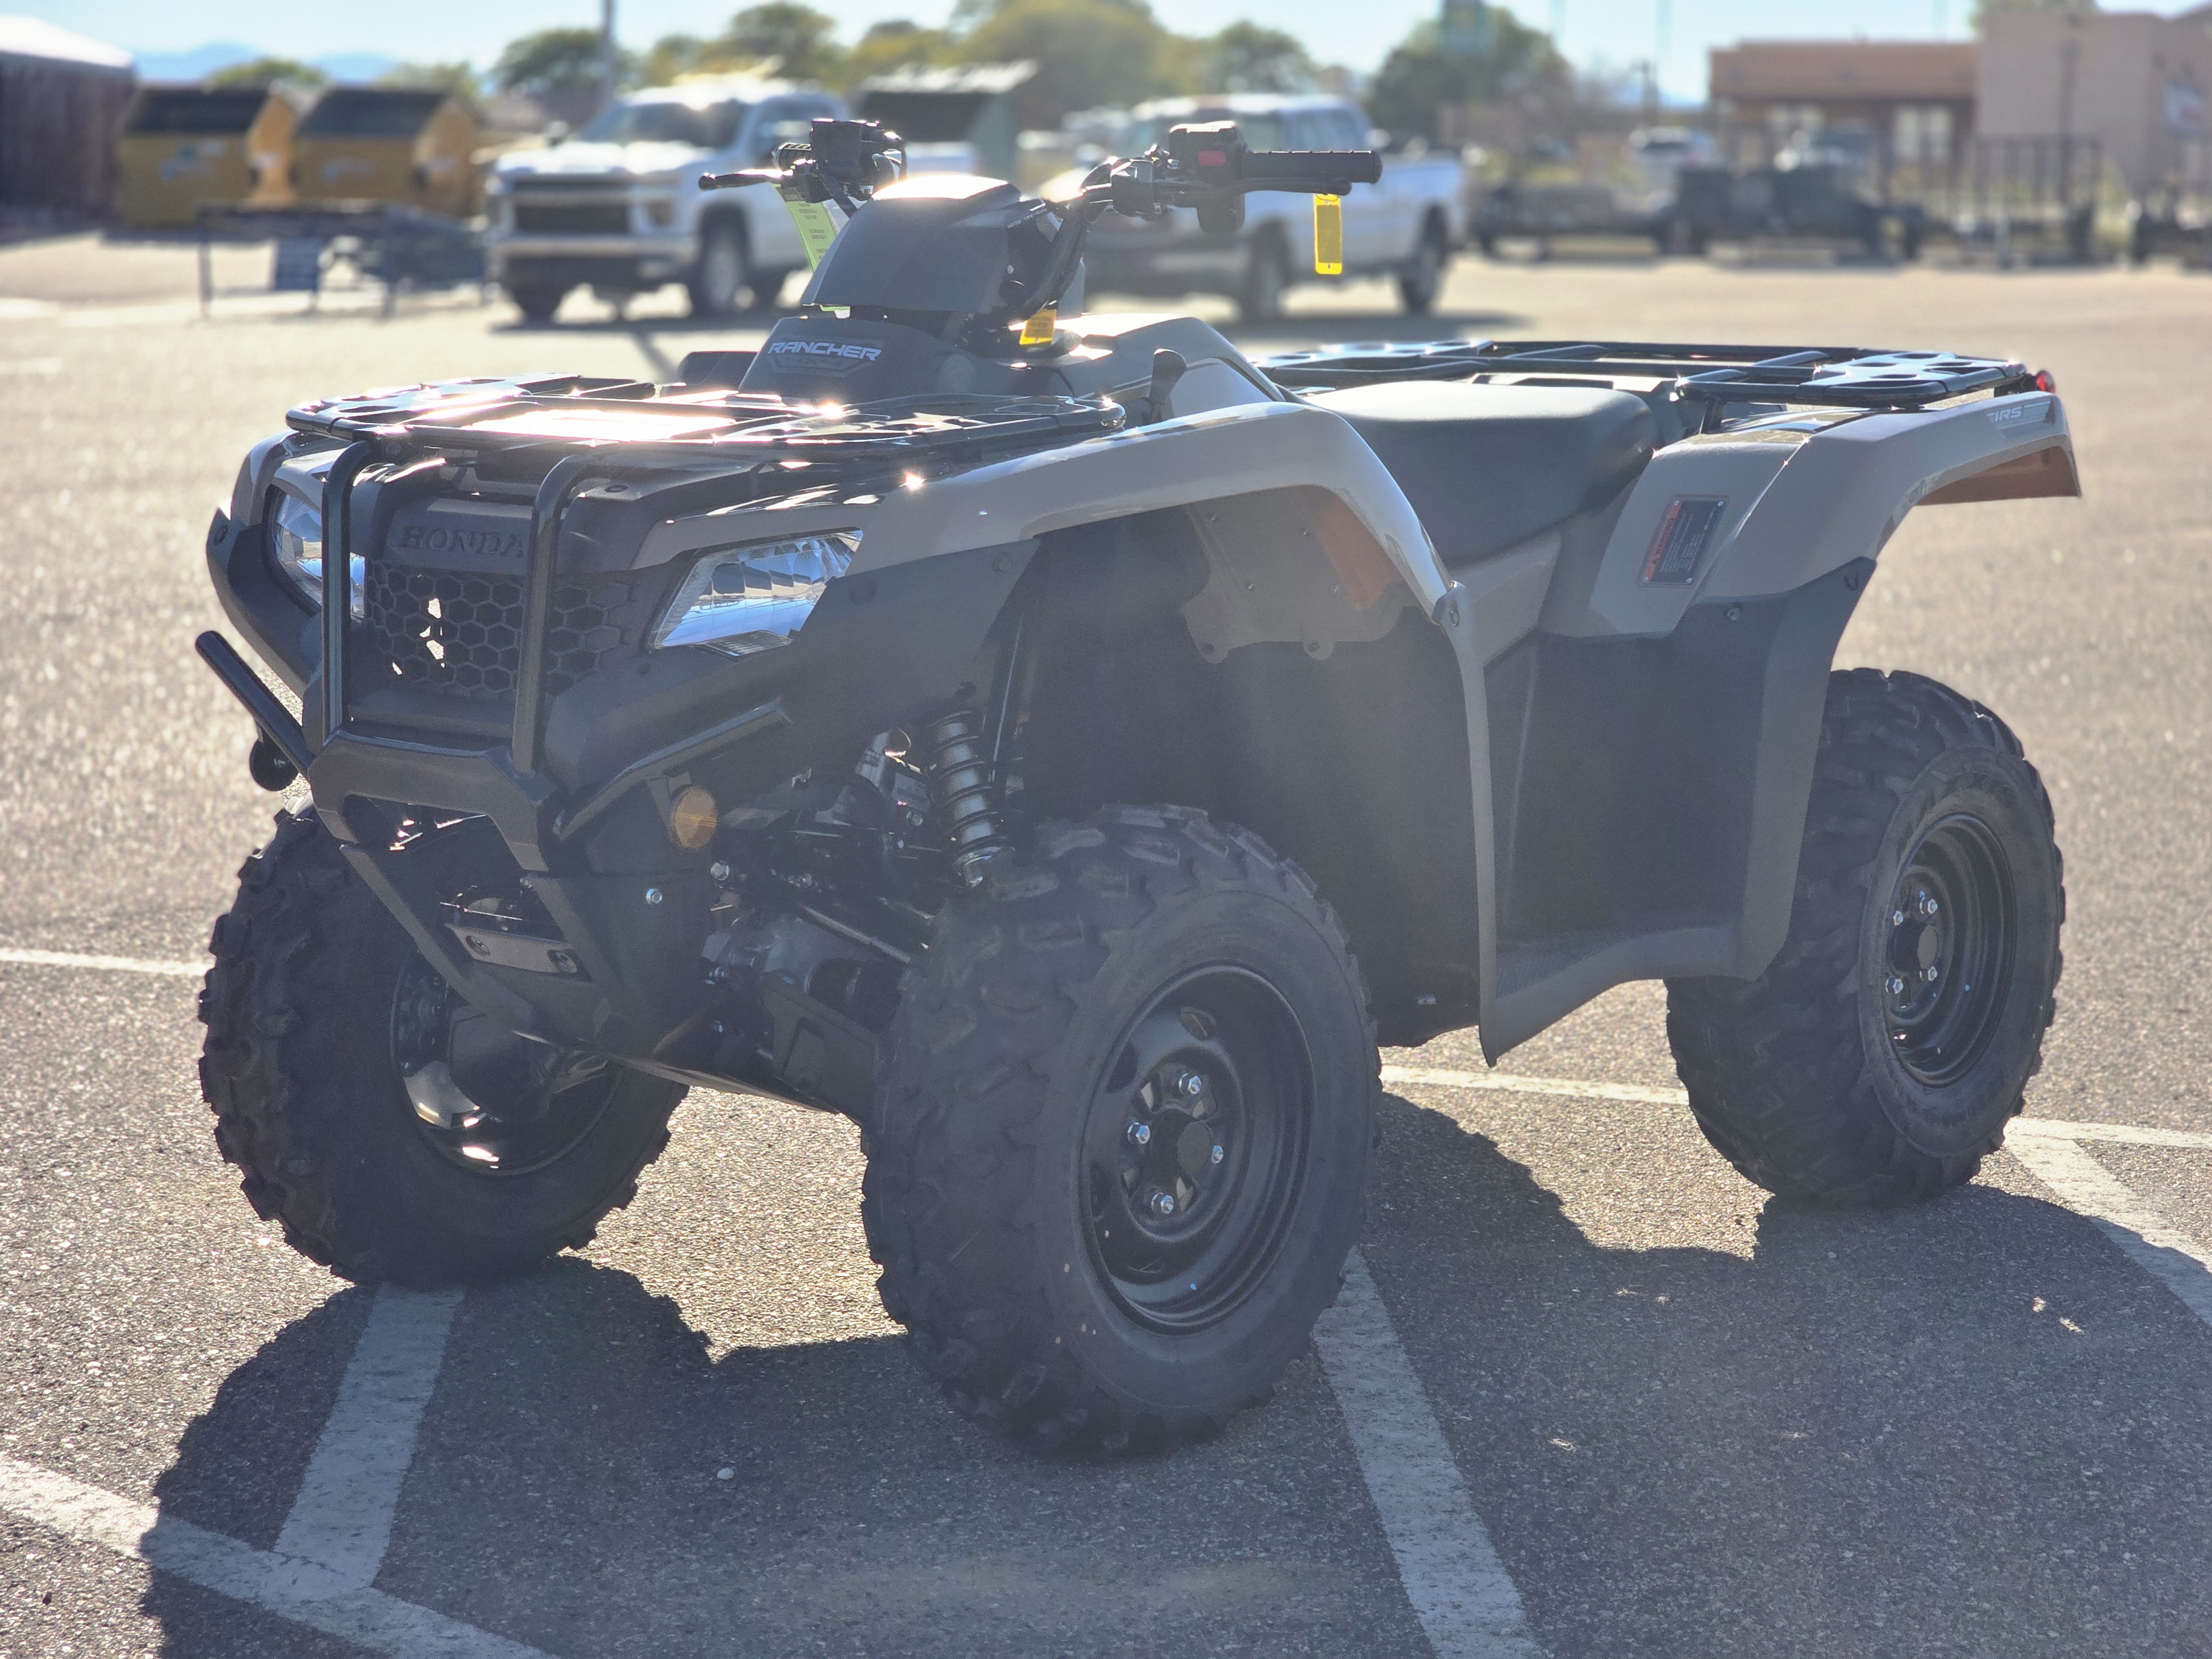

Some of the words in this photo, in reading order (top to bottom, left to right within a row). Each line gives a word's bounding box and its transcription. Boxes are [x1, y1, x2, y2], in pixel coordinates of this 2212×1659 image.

[768, 341, 881, 361] RANCHER
[1994, 406, 2022, 422] IRS
[399, 525, 525, 558] HONDA
